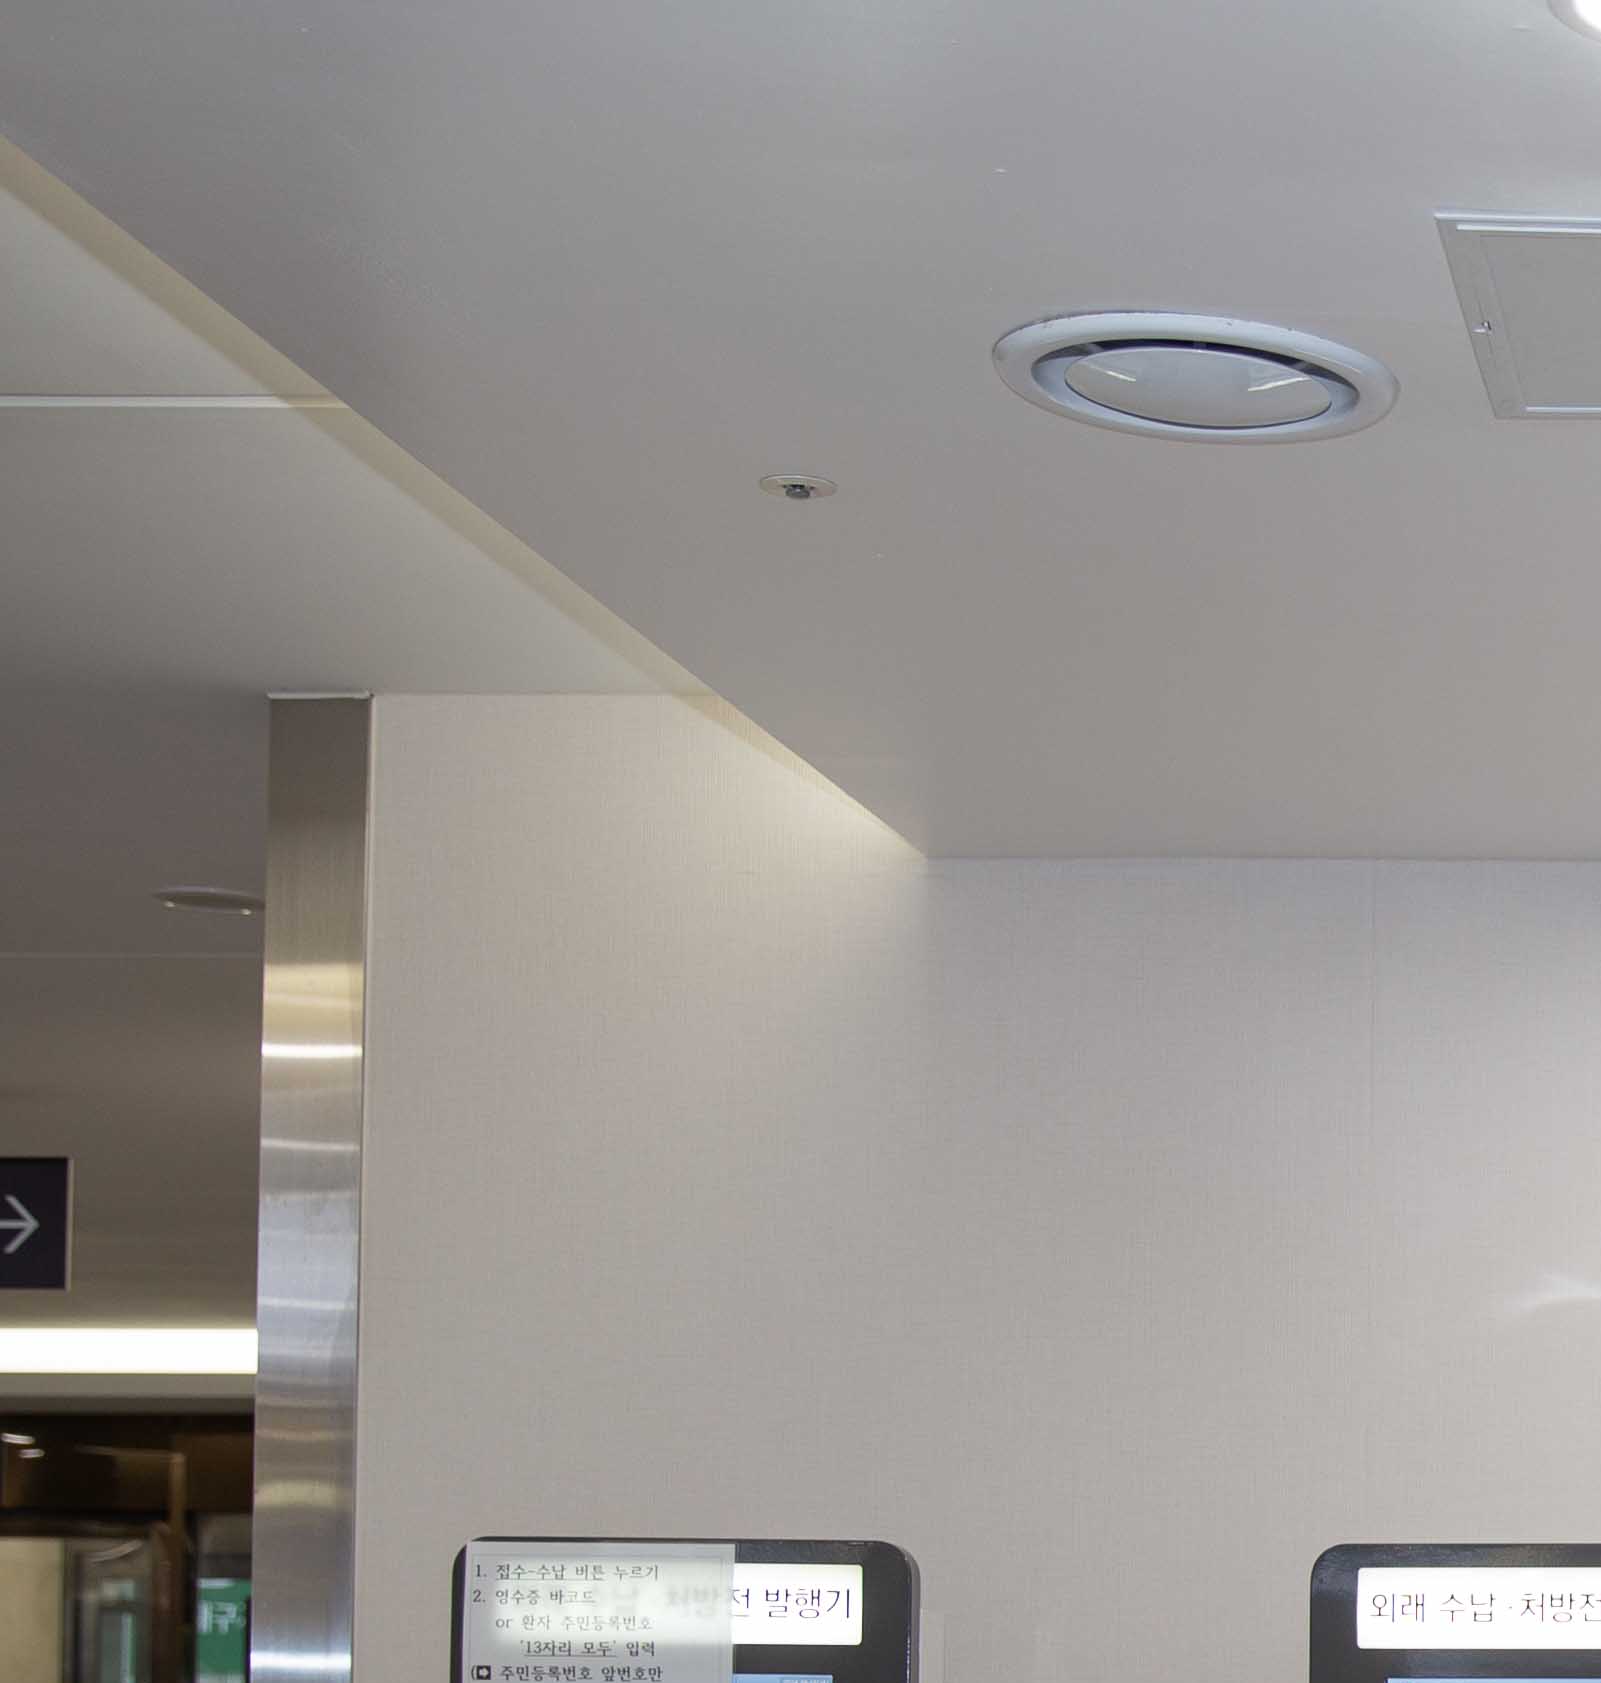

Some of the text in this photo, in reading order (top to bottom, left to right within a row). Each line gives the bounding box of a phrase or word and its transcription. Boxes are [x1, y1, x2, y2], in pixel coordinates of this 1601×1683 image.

[496, 1564, 566, 1579] 접수-수납
[614, 1565, 658, 1581] 누르기
[496, 1590, 596, 1605] 영수증 바코드
[765, 1588, 849, 1619] 발행기
[1370, 1593, 1424, 1622] 외래
[1439, 1593, 1496, 1622] 수납
[496, 1616, 653, 1631] or 환자 주민등록번호
[626, 1642, 655, 1657] 입력
[500, 1666, 663, 1682] 주민등록번호 앞번호만
